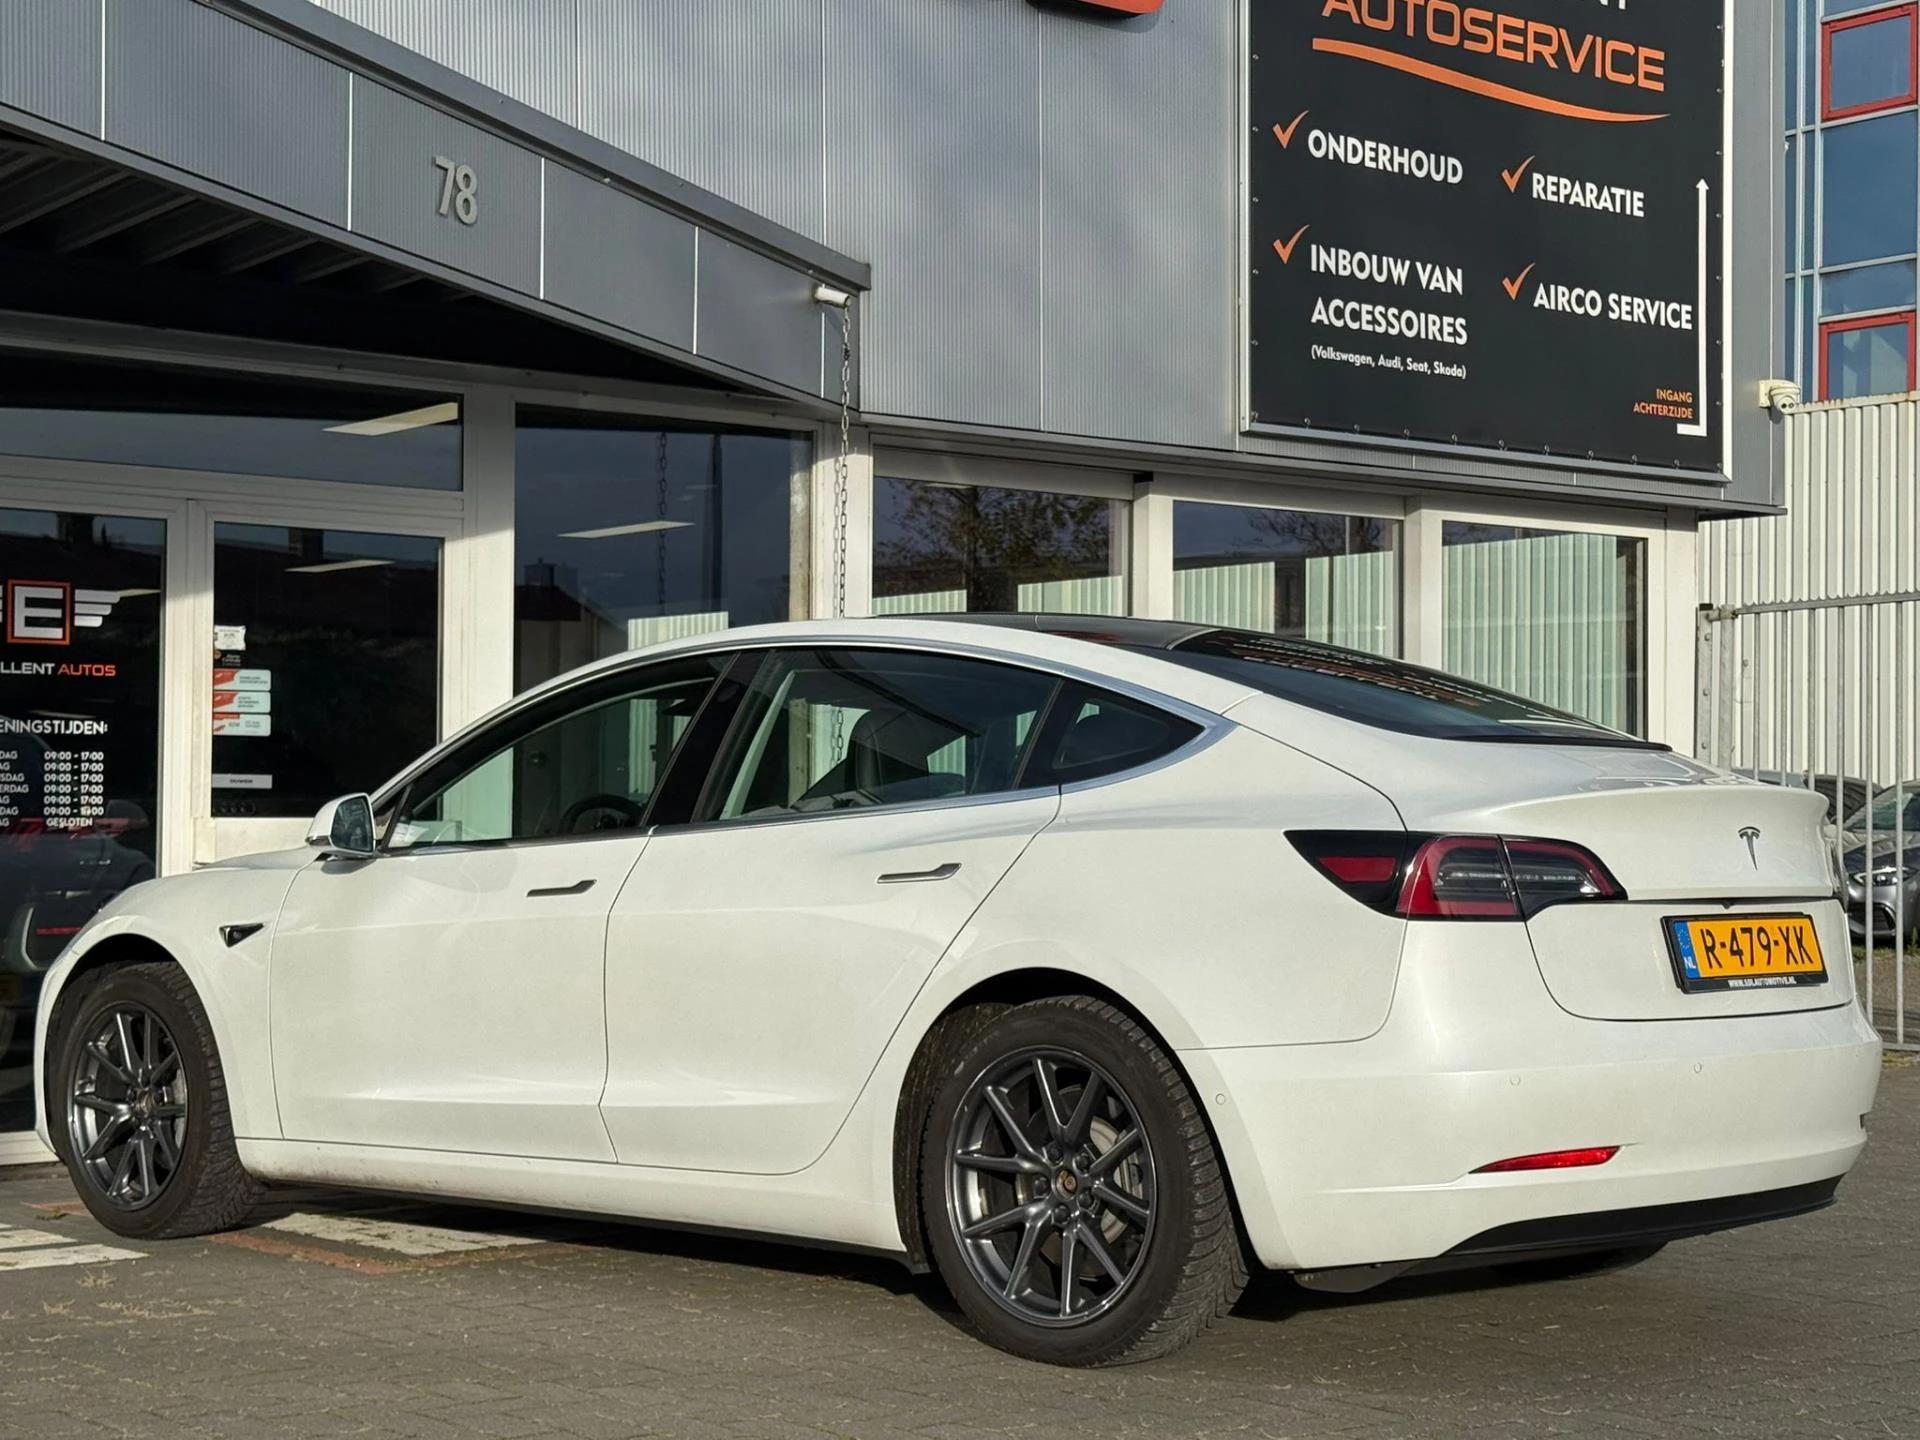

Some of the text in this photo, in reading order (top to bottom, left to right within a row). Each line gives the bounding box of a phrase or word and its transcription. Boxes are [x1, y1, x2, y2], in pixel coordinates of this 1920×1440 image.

[1308, 129, 1463, 184] ONDERHOUD
[433, 155, 478, 225] 78
[1532, 172, 1645, 217] REPARATIE
[1310, 244, 1463, 295] INBOUW VAN
[1310, 296, 1468, 345] ACCESSOIRES
[1533, 282, 1693, 330] AIRCO SERVICE
[1311, 344, 1467, 379] (Volkswagen, Audi, Seat, Skoda)
[1633, 402, 1693, 419] ACHTERZIJDE
[1655, 388, 1693, 403] INGANG
[58, 664, 116, 677] AUTOS
[1683, 955, 1697, 970] NL
[1700, 926, 1814, 969] R-479-XK
